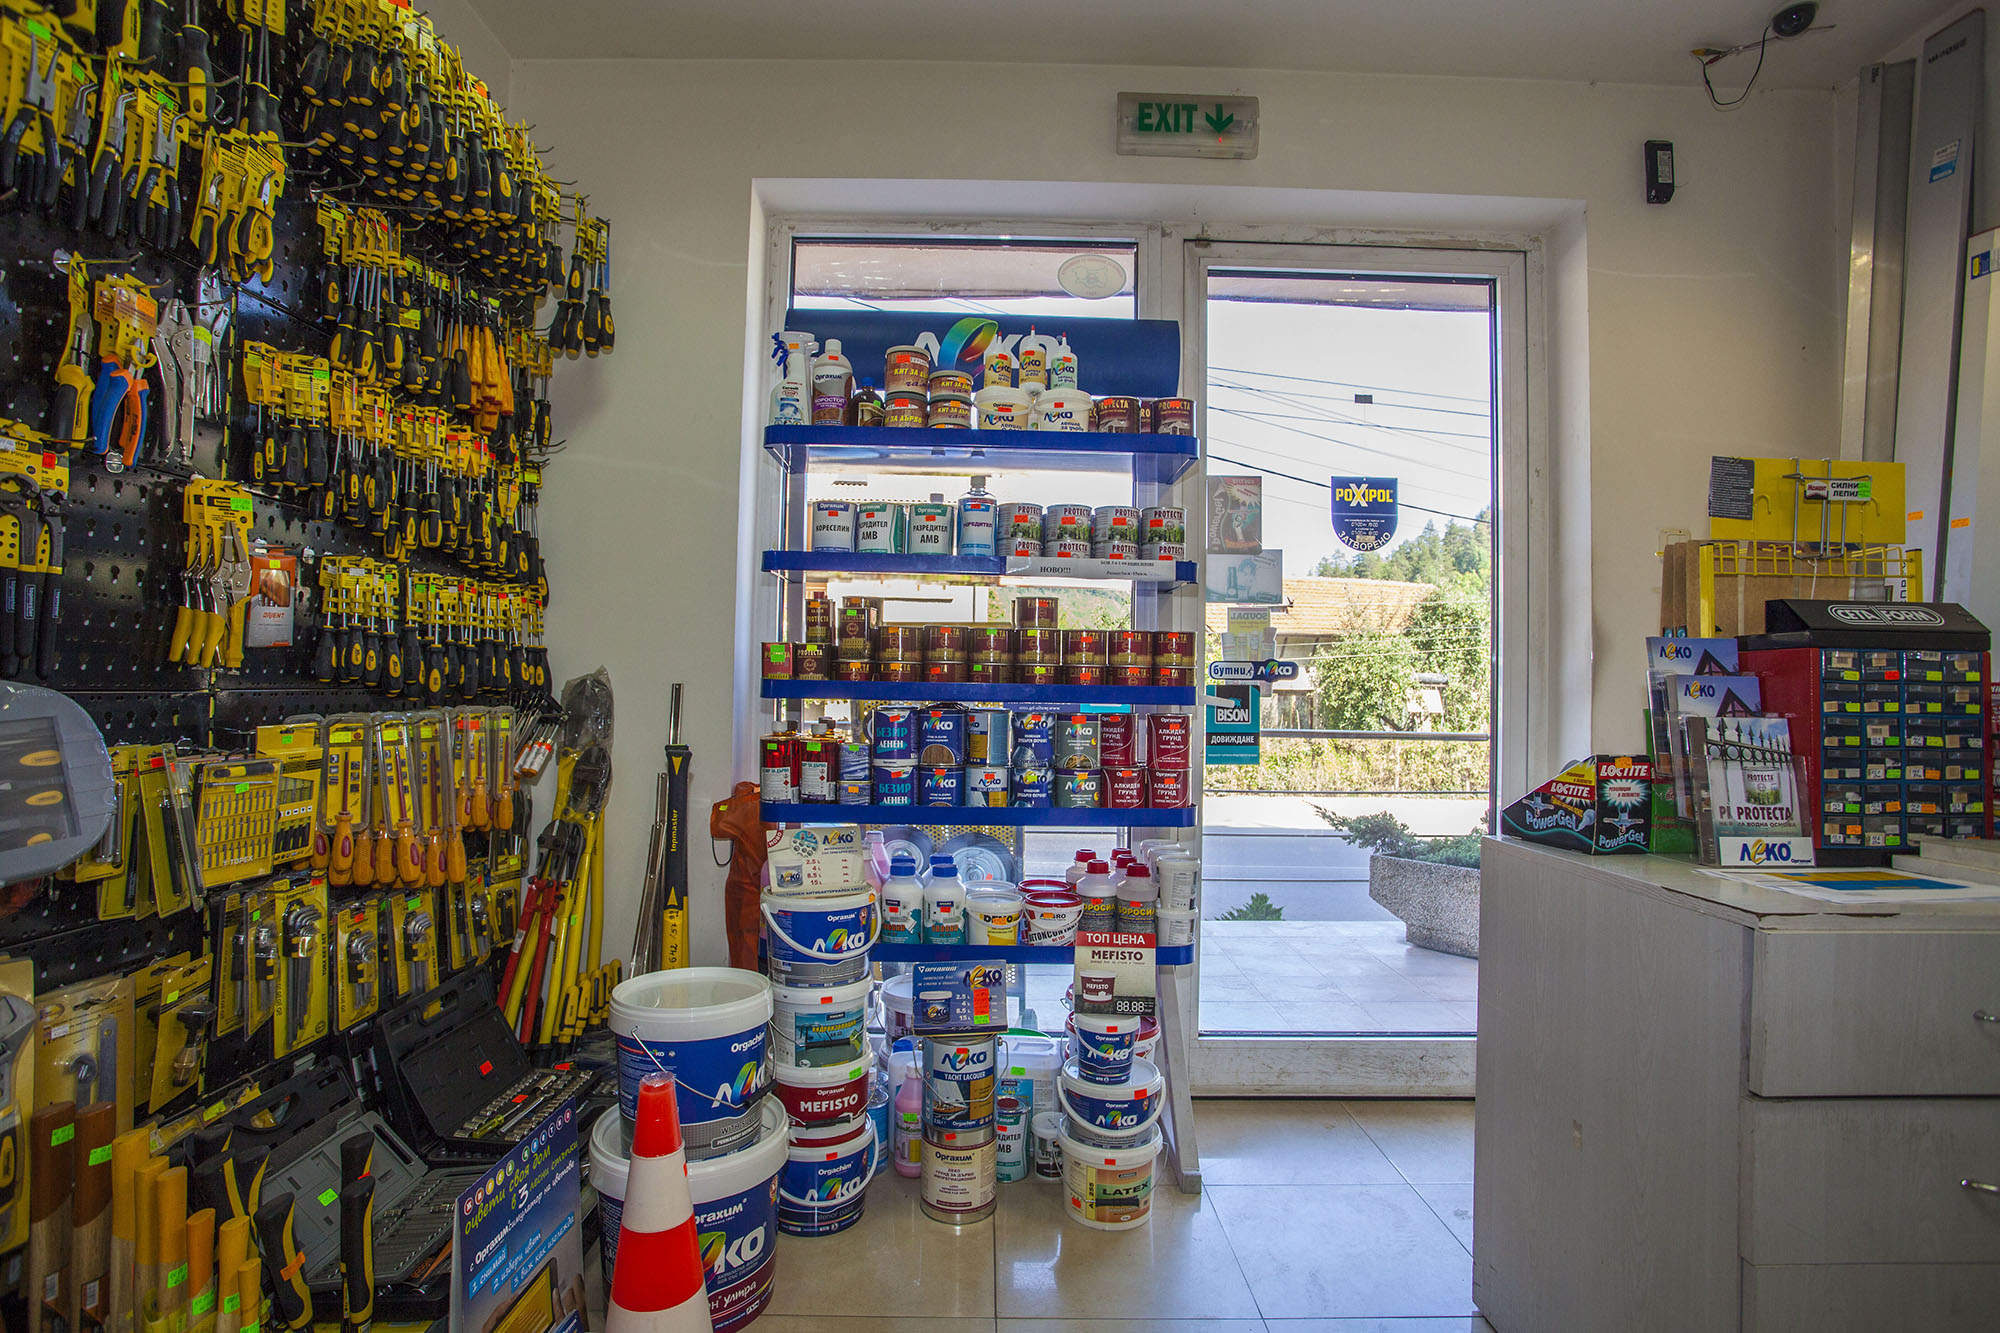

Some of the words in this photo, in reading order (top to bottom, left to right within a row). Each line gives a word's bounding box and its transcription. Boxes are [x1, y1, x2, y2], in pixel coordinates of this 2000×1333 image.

[1138, 102, 1198, 133] EXIT
[894, 368, 908, 376] КИТ
[1044, 411, 1072, 423] ЛЕКО
[1336, 483, 1394, 507] POXIPOL
[1338, 531, 1391, 550] ЗАТВОРЕНО
[1040, 566, 1072, 574] НОВО!!!
[1837, 608, 1874, 620] CETA
[1883, 610, 1935, 622] FORM
[1660, 642, 1692, 660] ЛЕКО
[1214, 664, 1246, 678] бутни
[1257, 661, 1293, 682] ЛЕКО
[1684, 681, 1716, 698] ЛЕКО
[1217, 708, 1249, 722] BISON
[922, 717, 954, 732] ЛЕКО
[1065, 724, 1093, 738] ЛЕКО
[877, 728, 908, 738] БЕЗИР
[1211, 735, 1255, 745] ДОВИЖДАНЕ
[1600, 764, 1649, 777] LOCTITE
[1747, 774, 1774, 782] PROTECTA
[879, 784, 911, 794] БЕЗИР
[925, 776, 956, 790] ЛЕКО
[1065, 776, 1096, 794] ЛЕКО
[1551, 782, 1590, 798] LOCTITE
[1736, 806, 1792, 820] PROTECTA
[1526, 810, 1580, 832] PowerGel
[670, 809, 678, 852] topmaster
[822, 830, 854, 846] ЛЕКО
[768, 832, 782, 848] НОВО
[1600, 830, 1647, 848] PowerGel
[1740, 838, 1792, 865] ЛЕКО
[230, 856, 254, 865] TOPEX
[827, 913, 856, 922] Оргахим
[812, 928, 866, 954] ЛЕКО
[1086, 933, 1110, 944] ТОП
[1113, 934, 1146, 945] ЦЕНА
[1092, 950, 1144, 960] MEFISTO
[963, 965, 1002, 985] ЛЕКО
[1116, 1000, 1145, 1012] 88.88
[941, 1048, 987, 1072] ЛЕКО
[944, 1073, 962, 1081] YACHT
[963, 1072, 986, 1080] LACQUER
[817, 1087, 845, 1096] Оргахим
[800, 1093, 859, 1113] MEFISTO
[1096, 1110, 1138, 1130] ЛЕКО
[936, 1151, 973, 1162] Оргахим
[509, 1164, 530, 1192] своя
[533, 1145, 550, 1170] дом
[818, 1162, 852, 1176] Orgachim
[1103, 1180, 1149, 1196] LATEX
[518, 1183, 528, 1209] 3
[476, 1225, 508, 1265] Оргахим
